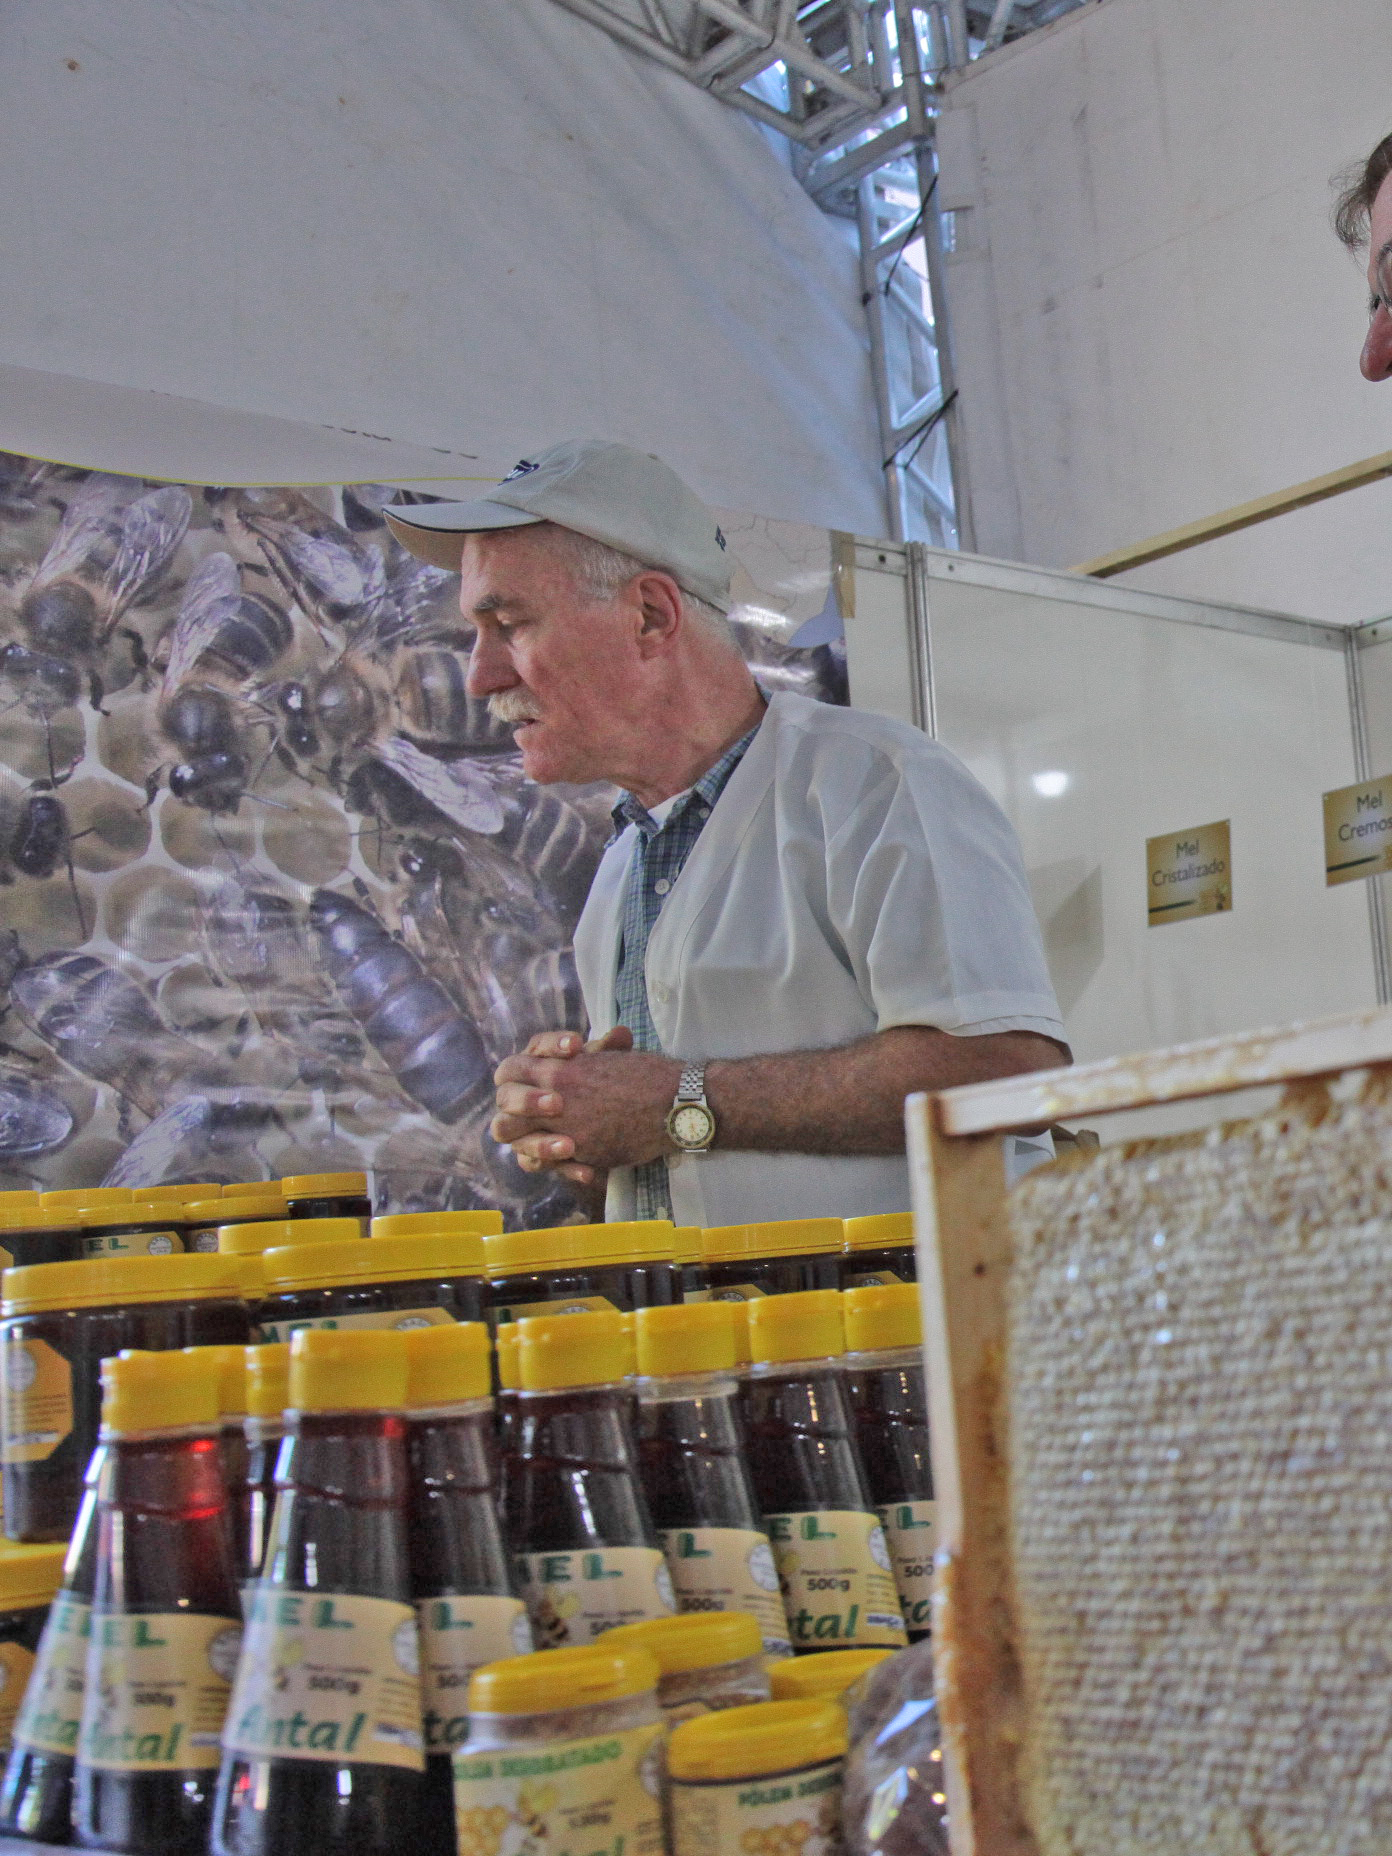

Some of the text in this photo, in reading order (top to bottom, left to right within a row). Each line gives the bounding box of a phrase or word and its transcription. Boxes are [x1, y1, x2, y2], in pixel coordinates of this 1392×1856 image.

[1356, 791, 1383, 813] Mel
[1175, 839, 1199, 858] Mel
[1151, 857, 1225, 886] Cristalizado
[87, 1237, 129, 1251] EL
[904, 1565, 935, 1578] 500
[807, 1578, 850, 1592] 500g
